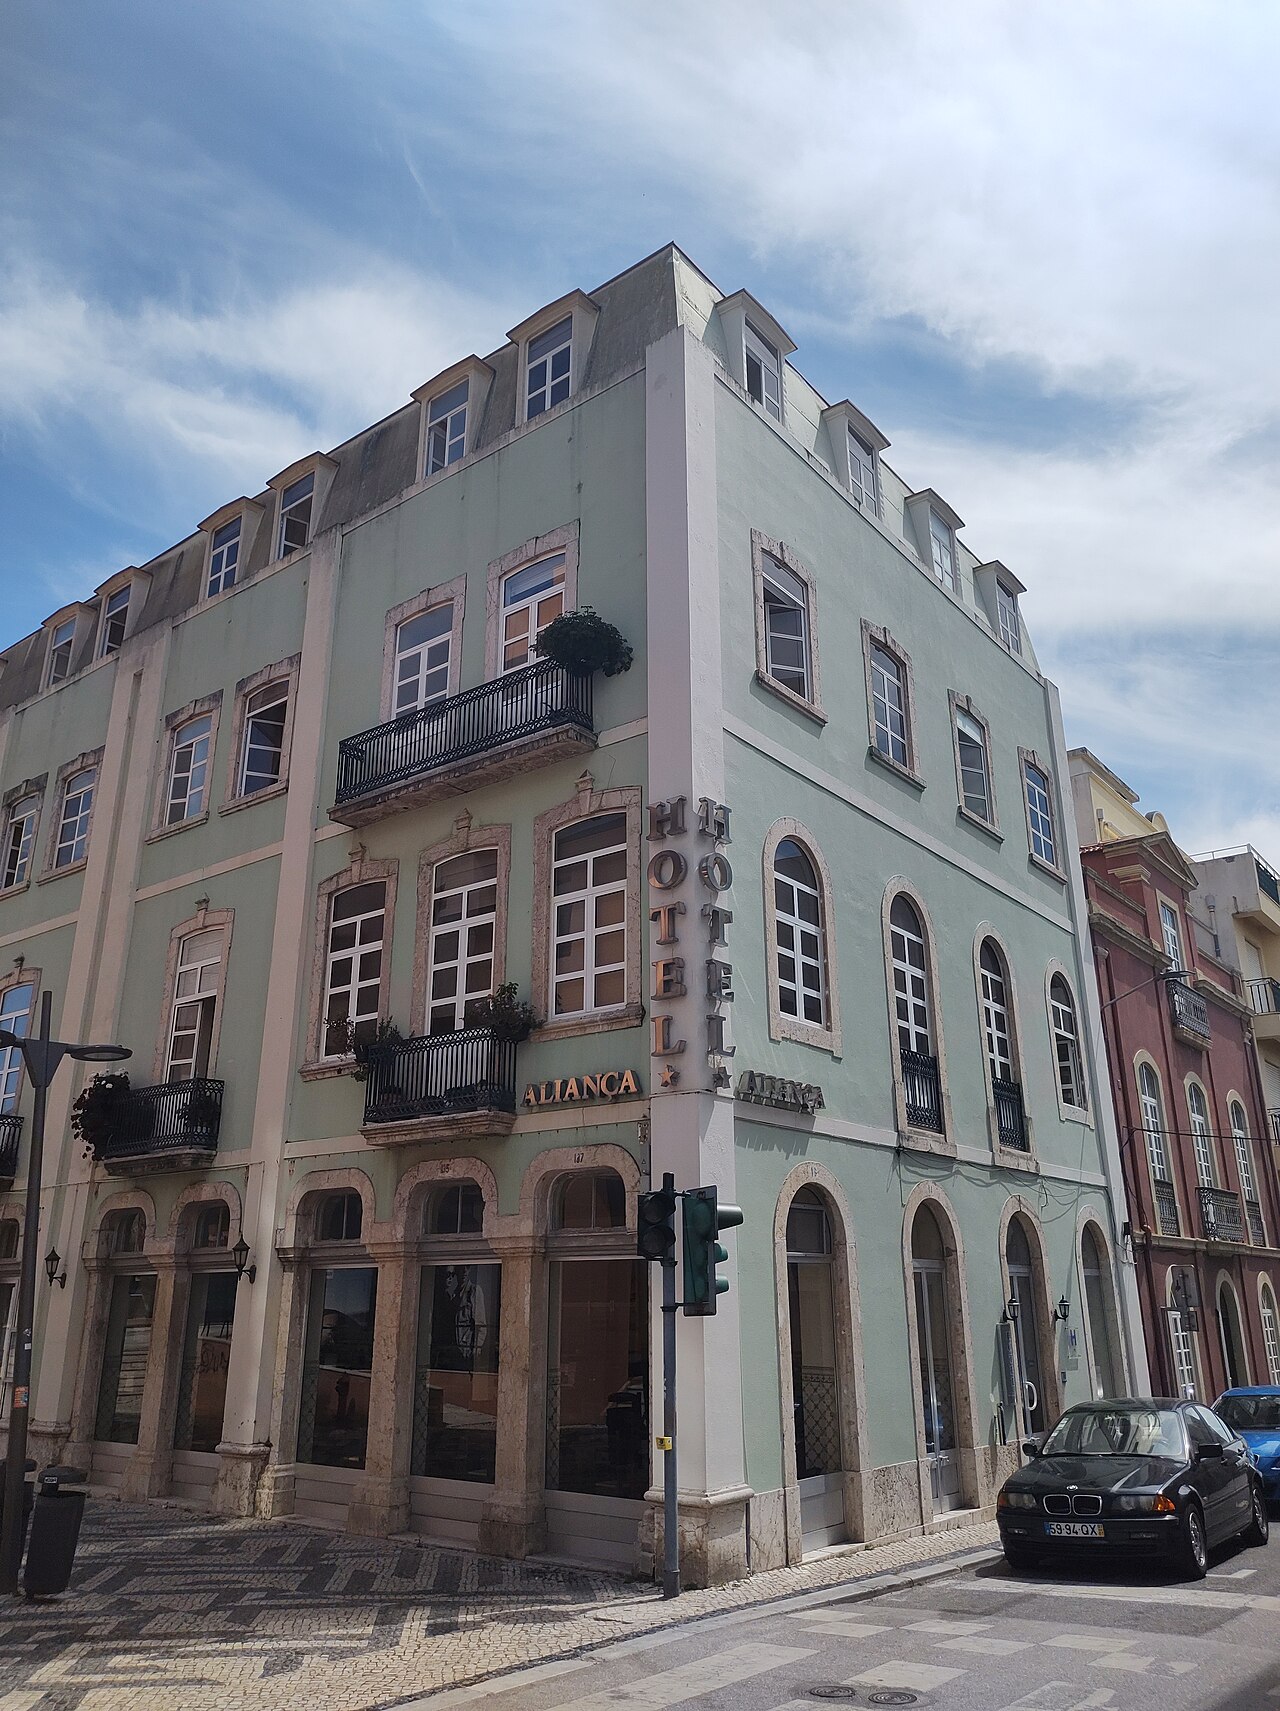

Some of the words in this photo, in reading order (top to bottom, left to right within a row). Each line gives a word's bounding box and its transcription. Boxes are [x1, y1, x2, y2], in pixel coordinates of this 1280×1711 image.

[646, 795, 688, 1057] HOTEL
[699, 796, 736, 1057] HOTEL
[520, 1069, 641, 1107] ALIANÇA
